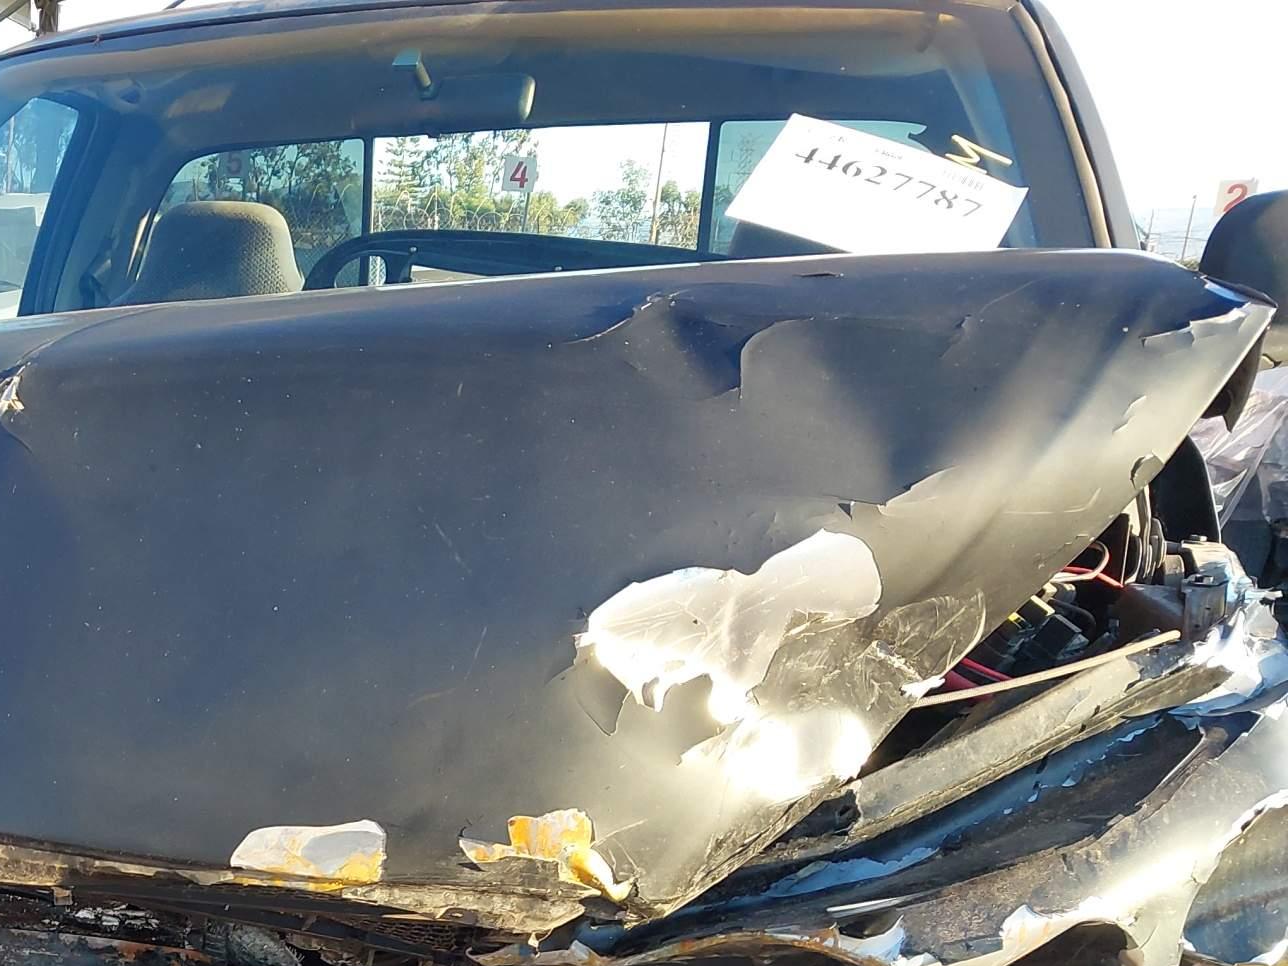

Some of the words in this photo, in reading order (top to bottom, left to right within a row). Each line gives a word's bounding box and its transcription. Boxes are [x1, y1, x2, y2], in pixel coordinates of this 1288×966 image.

[508, 160, 529, 189] 4
[793, 146, 985, 218] 44627787
[1222, 183, 1249, 213] 2
